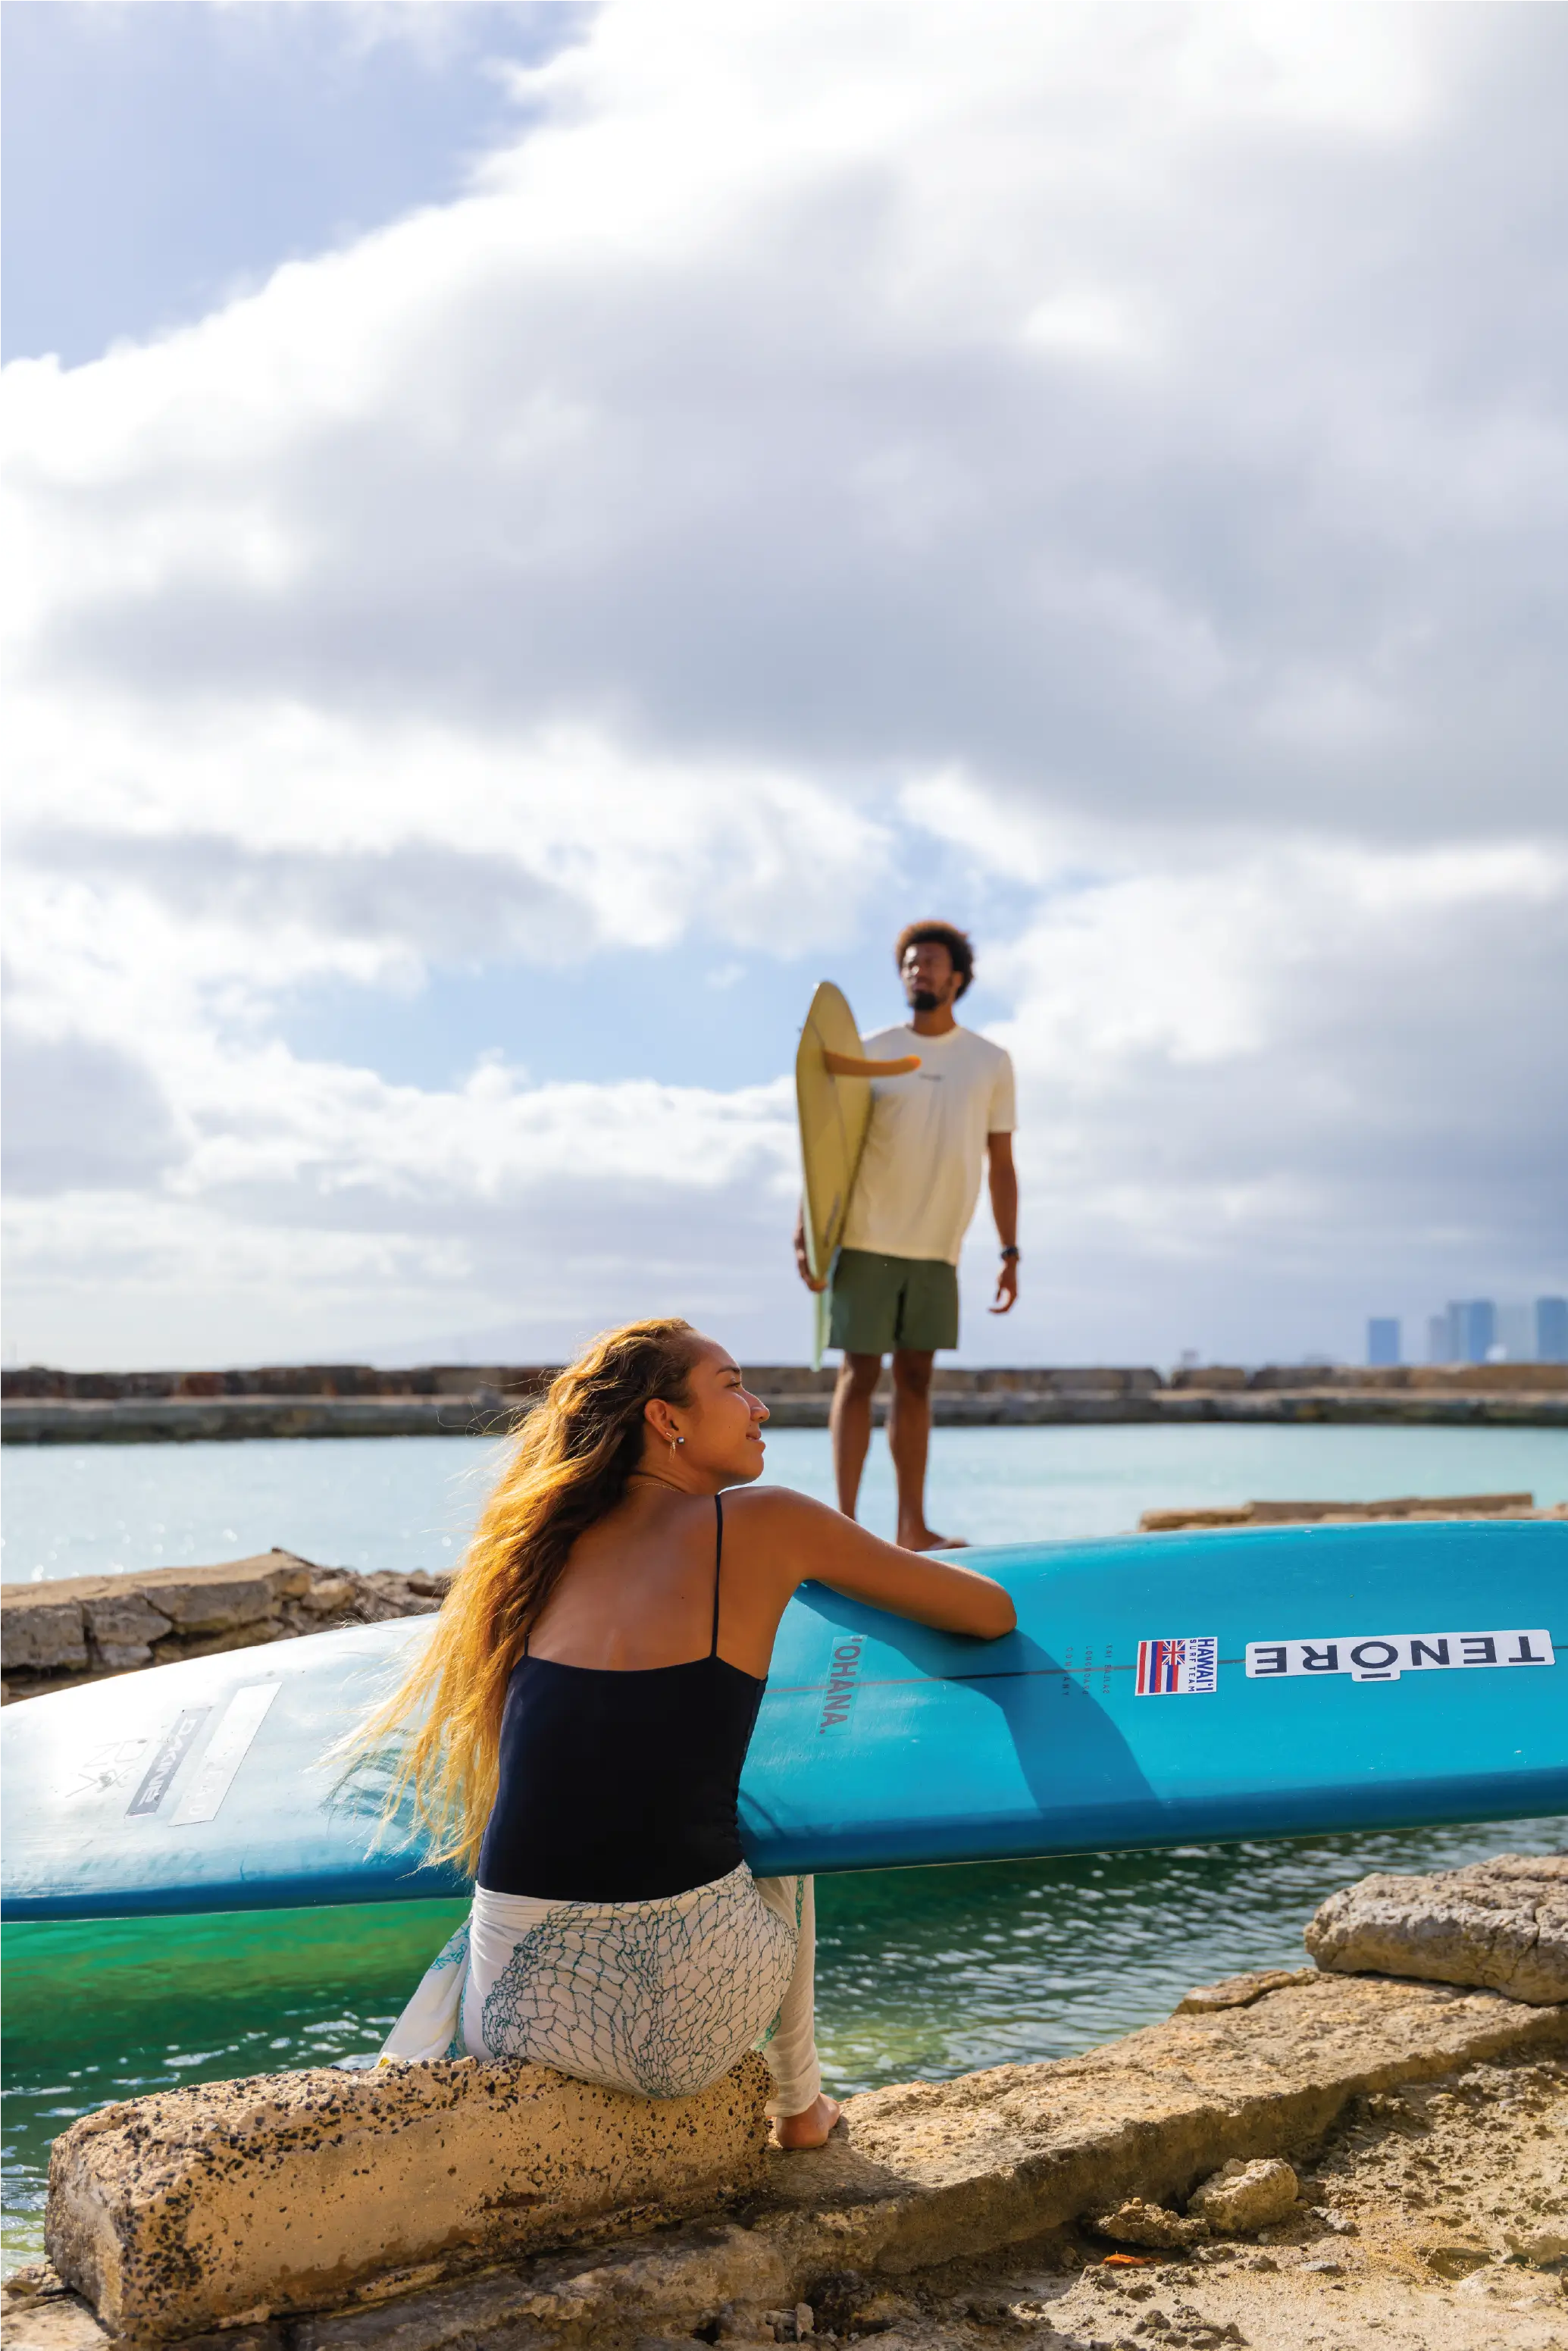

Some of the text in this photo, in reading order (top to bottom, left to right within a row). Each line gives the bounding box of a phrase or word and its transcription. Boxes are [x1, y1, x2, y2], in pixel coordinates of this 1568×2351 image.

[1063, 1647, 1073, 1695] COMANY
[1188, 1639, 1197, 1692] SURF TEAM
